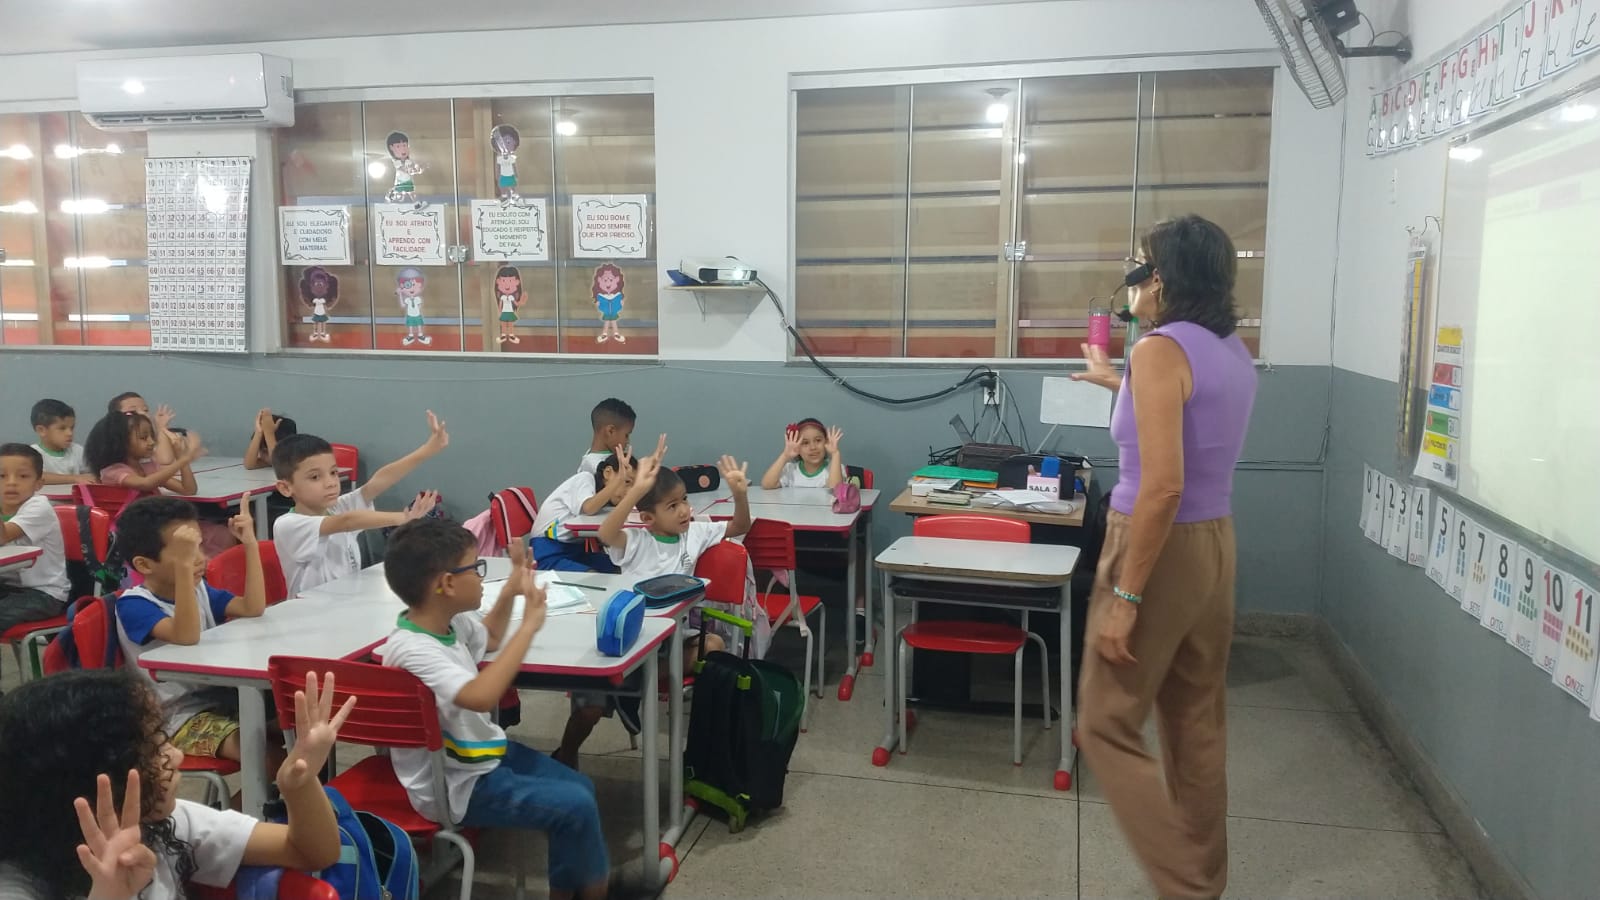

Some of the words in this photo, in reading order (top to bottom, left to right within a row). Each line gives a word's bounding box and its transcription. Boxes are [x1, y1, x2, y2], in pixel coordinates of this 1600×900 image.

[1458, 48, 1468, 78] G
[1479, 34, 1488, 68] H
[1424, 71, 1430, 98] E
[1440, 61, 1447, 90] F
[1383, 92, 1388, 116] B
[1395, 86, 1402, 110] C
[1409, 80, 1416, 106] D
[1376, 475, 1380, 499] 1
[1390, 483, 1394, 509] 2
[1400, 491, 1406, 515] 3
[1417, 494, 1423, 520] 4
[1440, 506, 1447, 536] 5
[1459, 520, 1466, 549] 6
[1478, 532, 1485, 562] 7
[1500, 544, 1508, 578] 8
[1525, 558, 1533, 593] 9
[1544, 570, 1563, 612] 10
[1575, 588, 1593, 633] 11
[1565, 675, 1584, 696] ONZE
